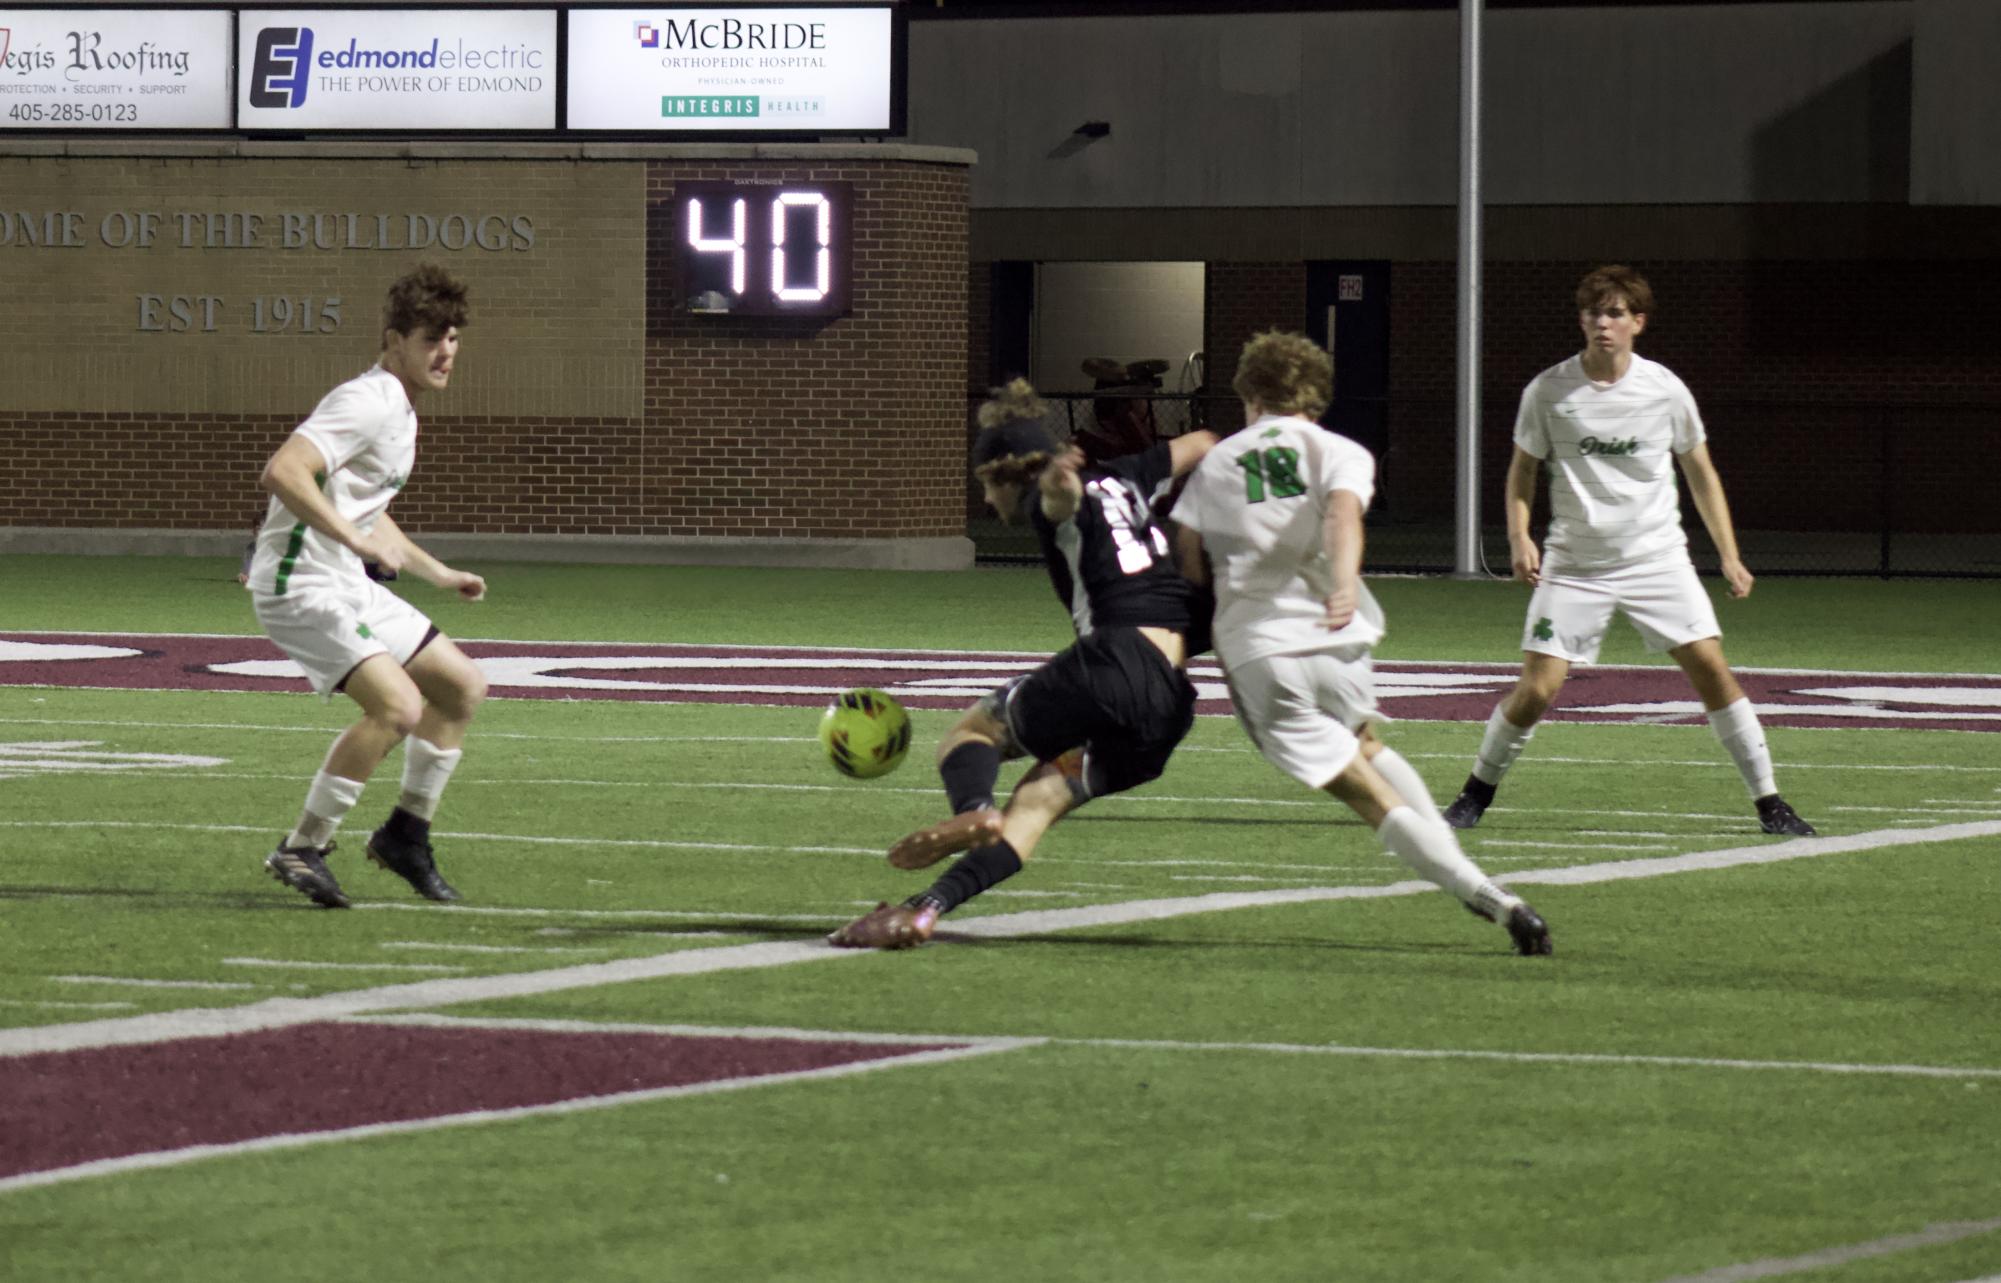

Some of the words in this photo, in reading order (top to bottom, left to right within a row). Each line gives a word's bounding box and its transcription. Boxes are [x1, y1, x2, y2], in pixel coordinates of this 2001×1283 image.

[65, 31, 190, 81] Roofing
[318, 38, 542, 68] edmondelectric
[662, 56, 754, 68] ORTHOPEDIC
[759, 56, 827, 68] HOSPITAL
[73, 84, 122, 94] SECURITY
[139, 84, 187, 94] SUPPORT
[318, 76, 352, 92] THE
[359, 76, 421, 92] POWER
[429, 76, 452, 92] OF
[459, 76, 542, 92] EDMOND
[9, 103, 138, 121] 405-285-0123
[668, 99, 754, 113] INTEGRIS
[767, 101, 819, 111] HEALTH
[100, 211, 161, 249] OF
[175, 211, 265, 249] THE
[279, 213, 536, 252] BULLDOGS
[688, 191, 830, 302] 40
[1339, 278, 1362, 297] FH2
[137, 293, 224, 333] EST
[251, 296, 342, 334] 1915
